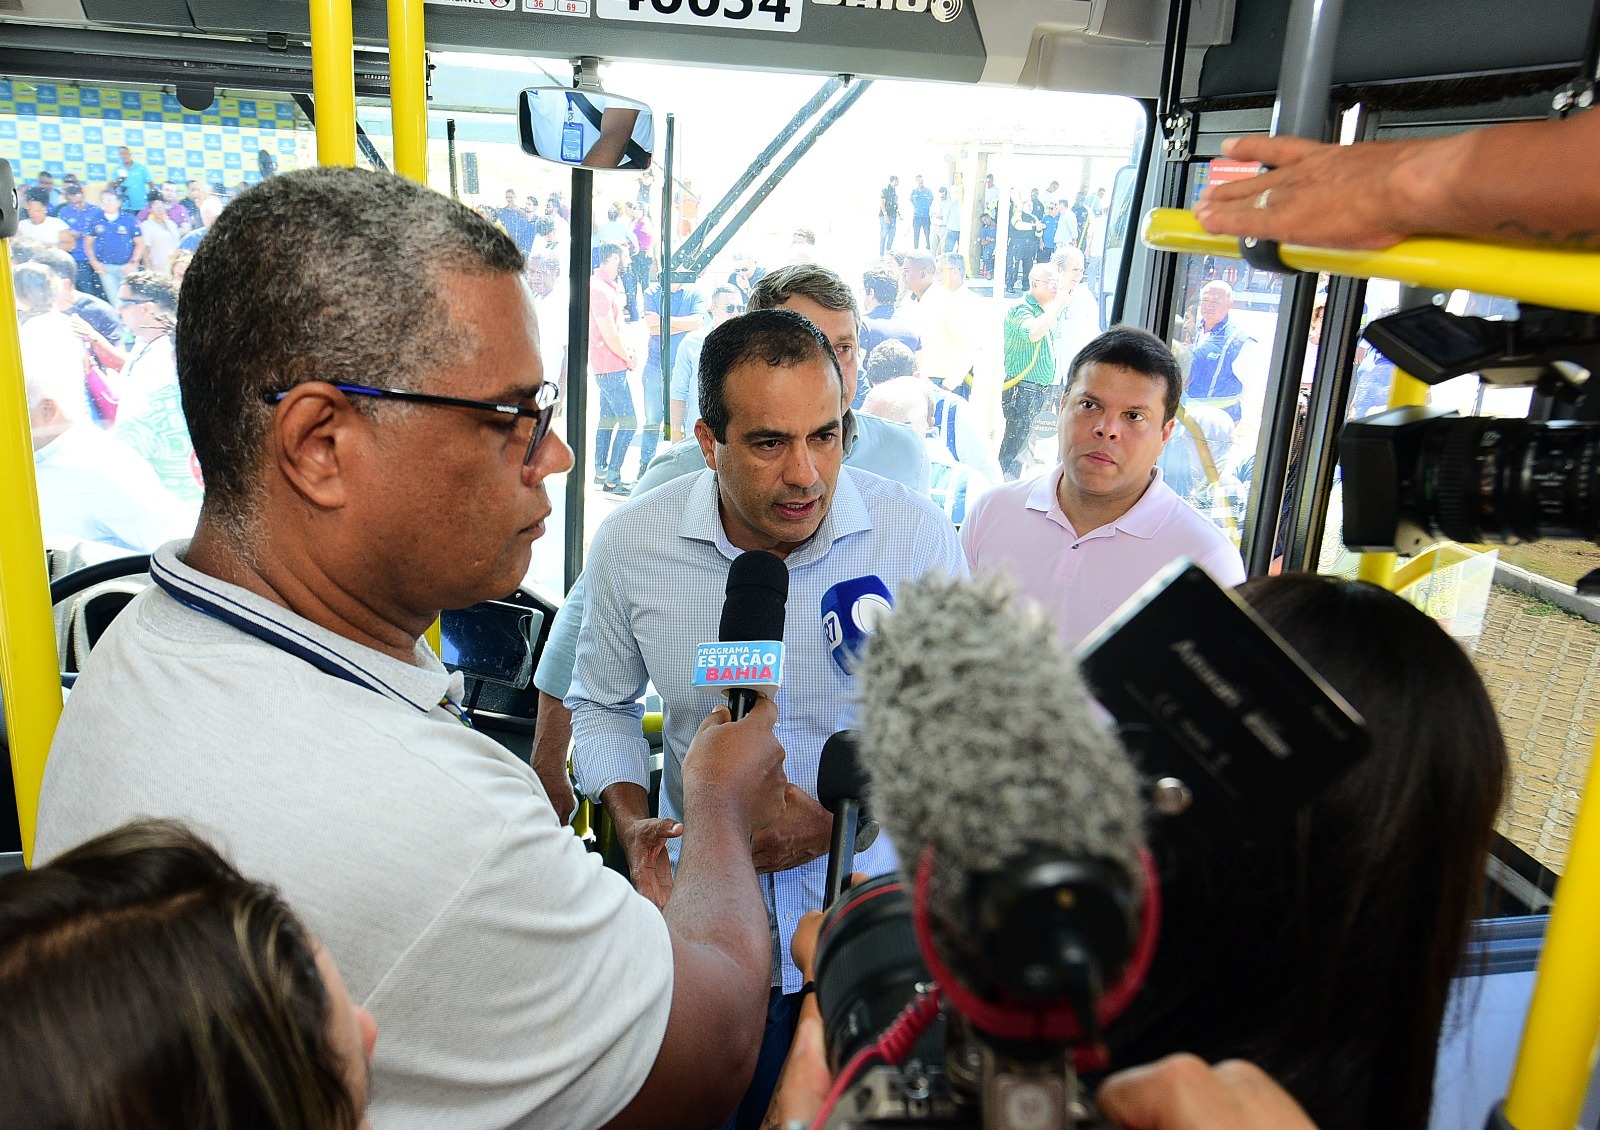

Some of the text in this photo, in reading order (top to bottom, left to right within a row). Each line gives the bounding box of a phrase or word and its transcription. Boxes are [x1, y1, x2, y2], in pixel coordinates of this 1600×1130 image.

[533, 0, 576, 11] 36 69
[698, 646, 750, 655] PROGRAMA
[698, 649, 776, 670] ESTAÇÃO
[705, 665, 773, 681] BAHIA
